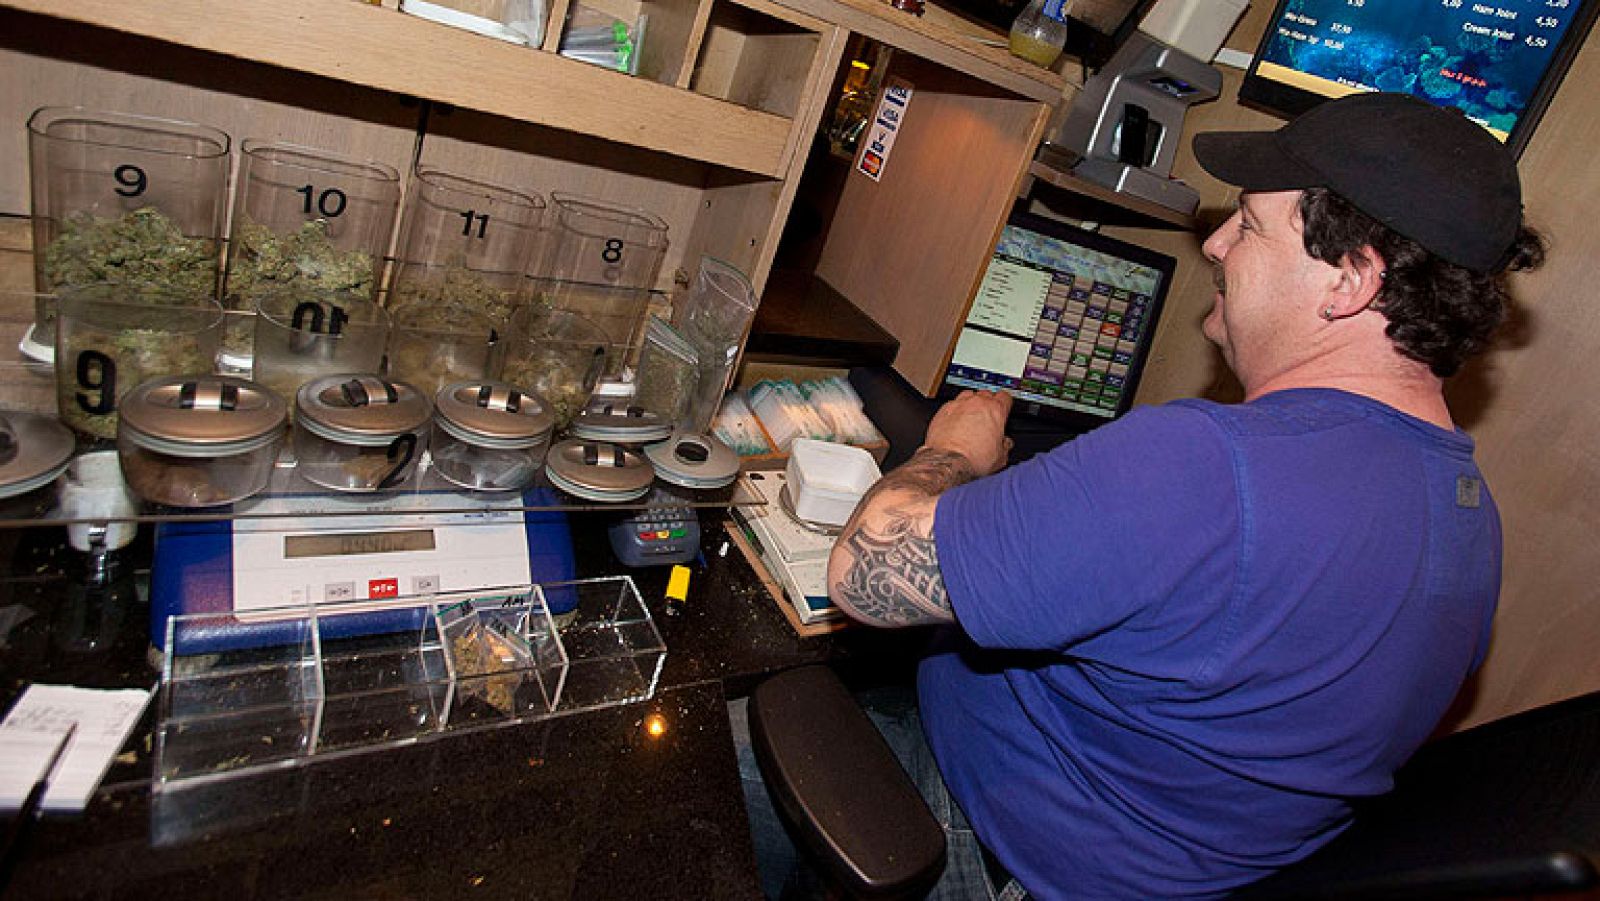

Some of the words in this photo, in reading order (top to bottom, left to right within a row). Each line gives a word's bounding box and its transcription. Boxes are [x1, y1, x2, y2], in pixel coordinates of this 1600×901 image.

[114, 164, 147, 197] 9
[297, 185, 347, 218] 10
[460, 210, 490, 239] 11
[601, 239, 624, 263] 8
[75, 350, 117, 416] 9
